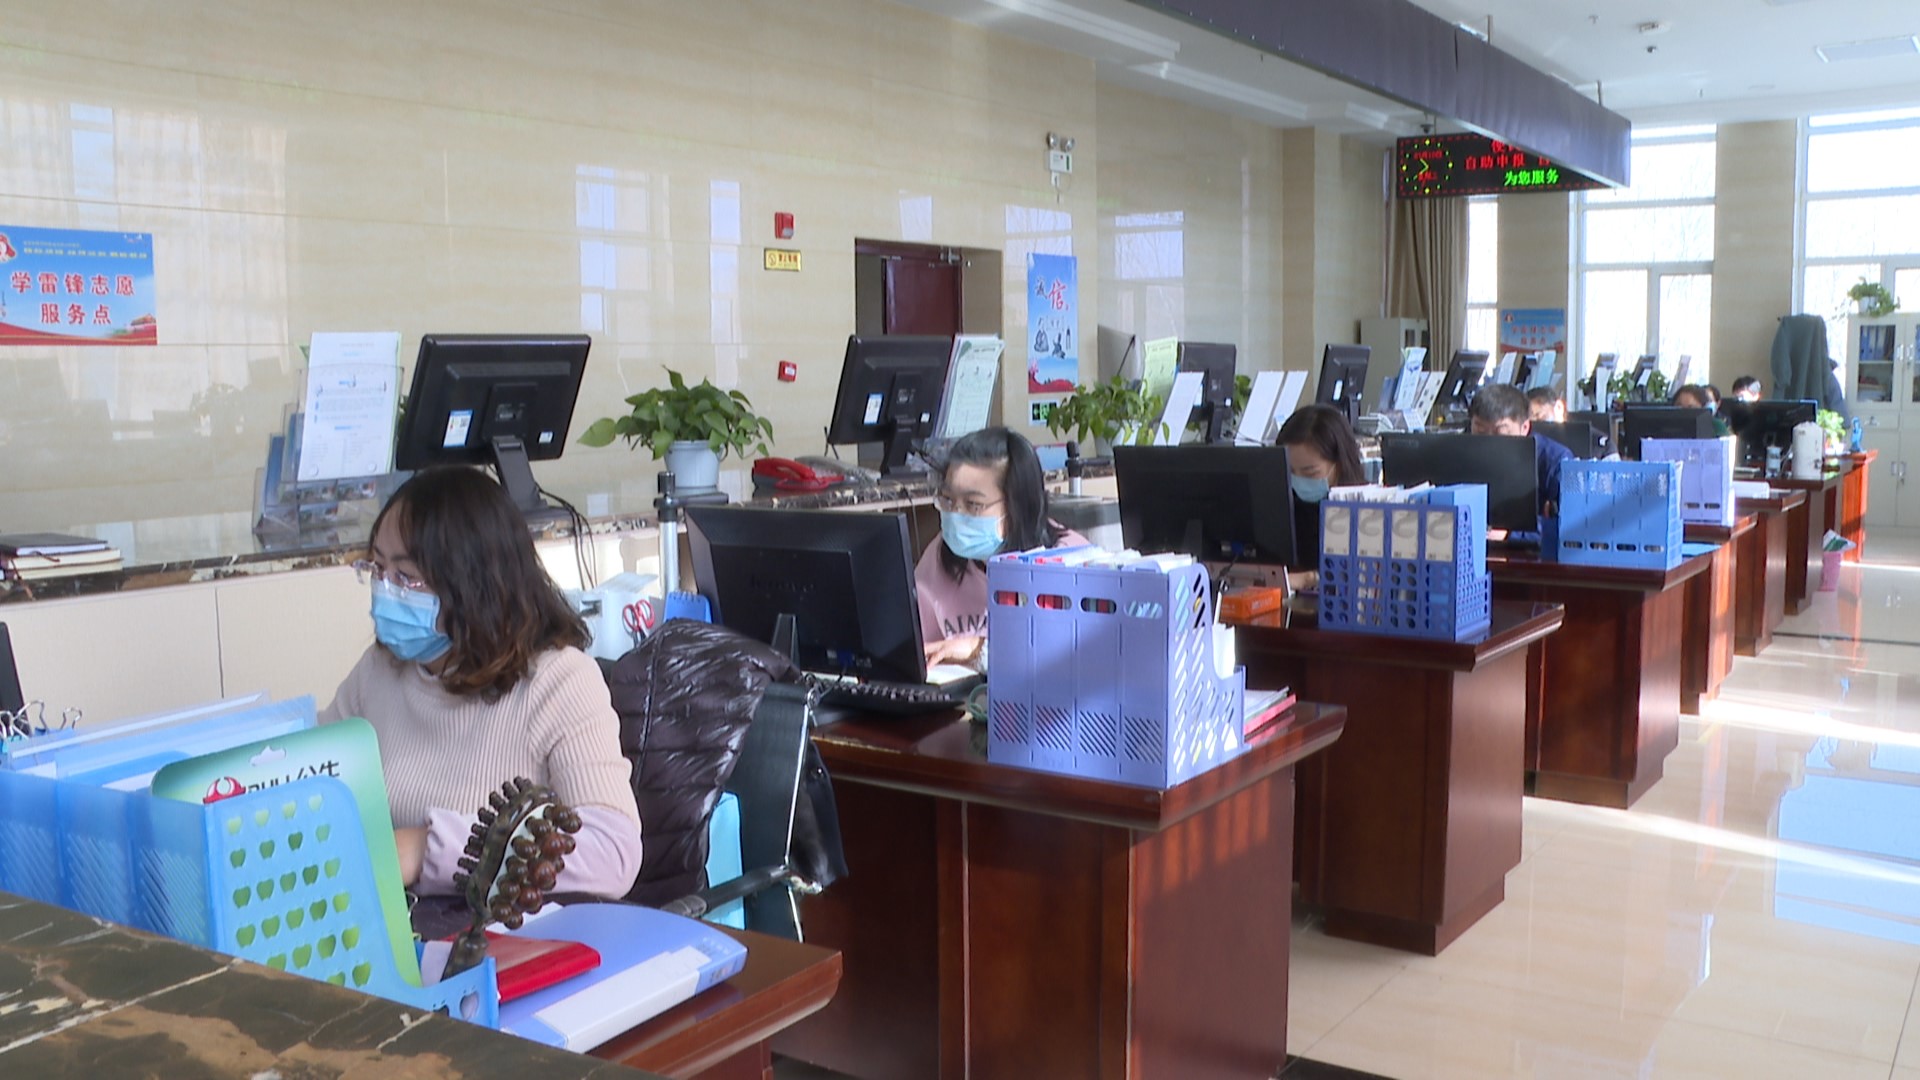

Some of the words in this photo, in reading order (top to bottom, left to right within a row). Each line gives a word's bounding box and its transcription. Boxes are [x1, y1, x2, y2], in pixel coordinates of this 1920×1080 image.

[1504, 168, 1559, 186] 为您服务
[11, 271, 135, 296] 学雷锋志愿
[41, 303, 111, 325] 服务点
